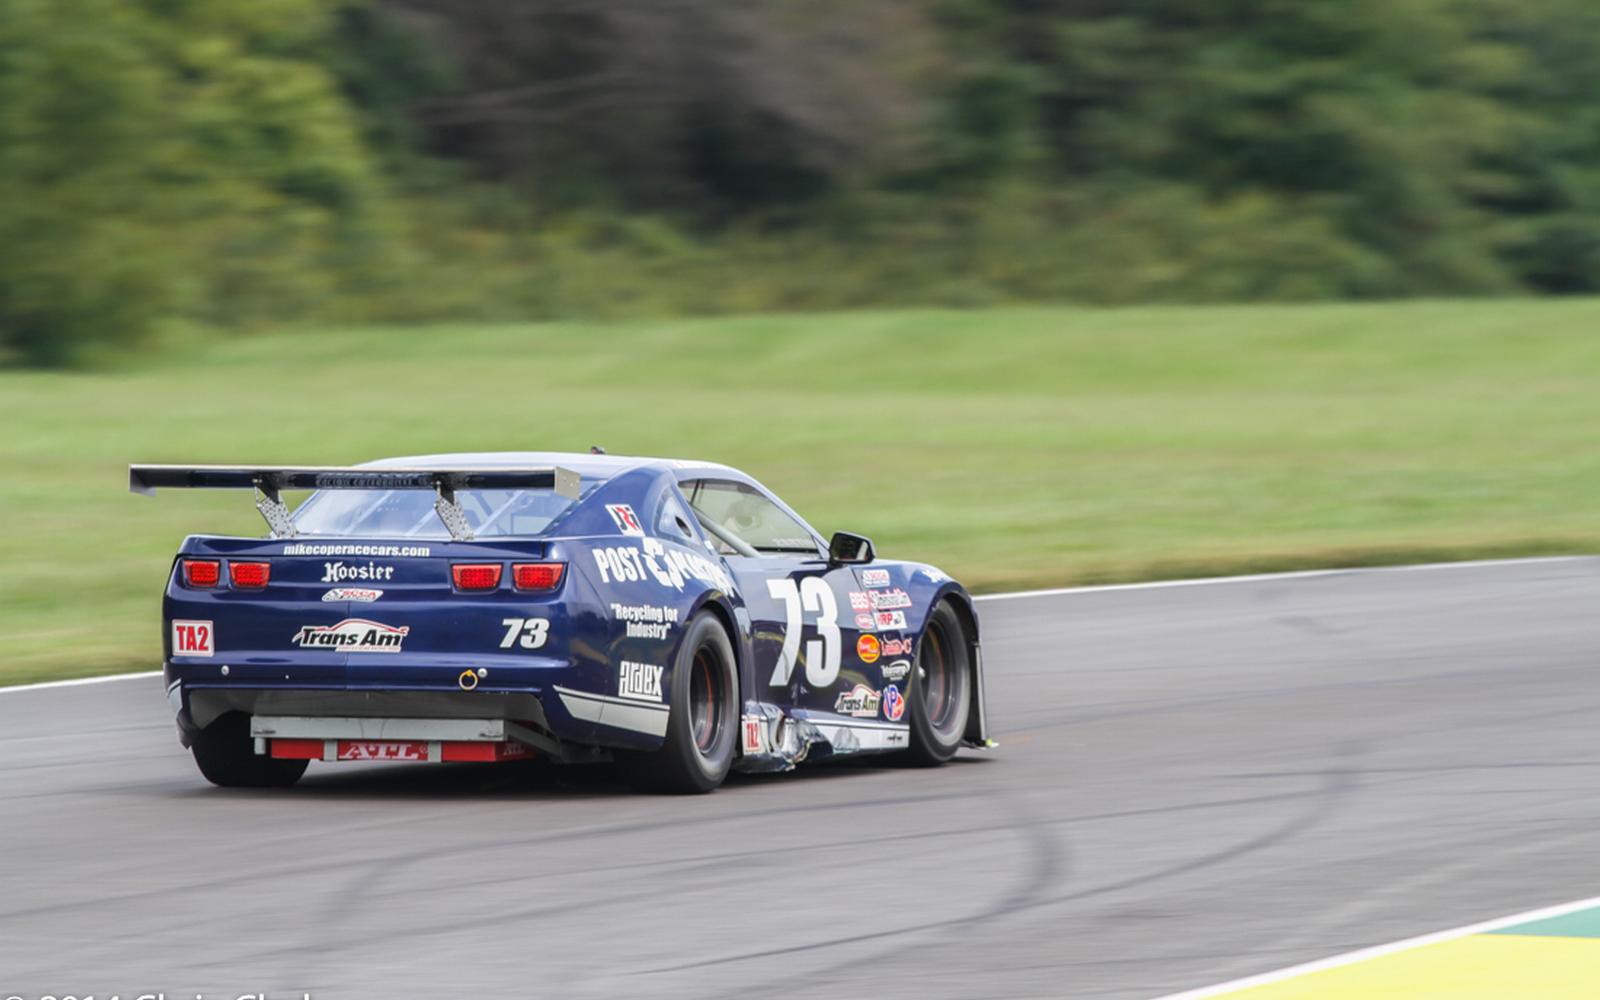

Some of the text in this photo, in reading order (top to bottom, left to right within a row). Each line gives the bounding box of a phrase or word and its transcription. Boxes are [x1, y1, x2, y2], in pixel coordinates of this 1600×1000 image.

[283, 544, 430, 557] mikecoperacecars.com
[321, 561, 394, 582] Hoosier
[592, 547, 647, 583] POST
[664, 606, 678, 622] for
[176, 625, 209, 651] TA2
[302, 627, 401, 647] Trans Am
[499, 618, 550, 649] 73
[766, 576, 842, 688] 73
[837, 694, 879, 711] Trans Am
[338, 743, 419, 760] ATL
